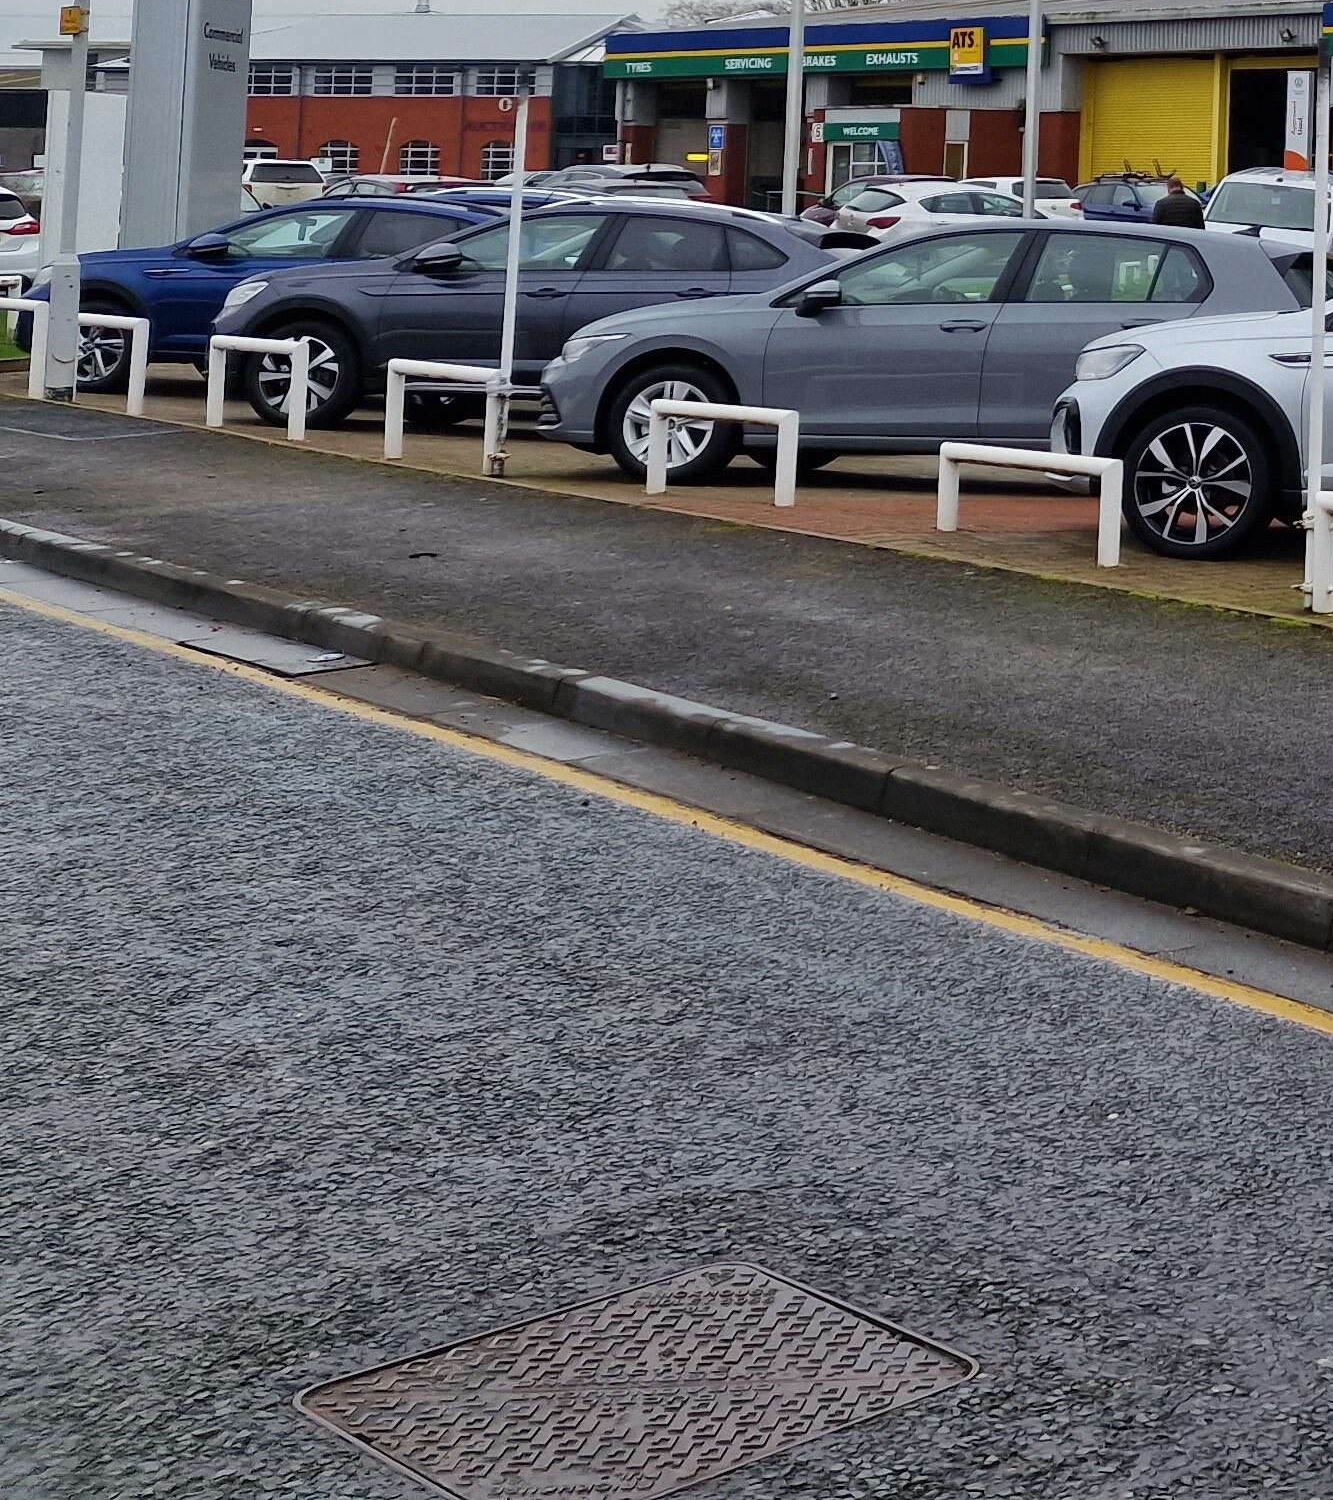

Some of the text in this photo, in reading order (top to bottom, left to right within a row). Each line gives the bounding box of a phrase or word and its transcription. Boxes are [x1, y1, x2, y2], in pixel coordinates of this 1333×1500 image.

[952, 31, 975, 49] ATS
[625, 62, 652, 73] TYRES
[725, 58, 772, 69] SERVICING
[866, 53, 918, 65] EXHAUSTS
[843, 127, 879, 136] WELCOME
